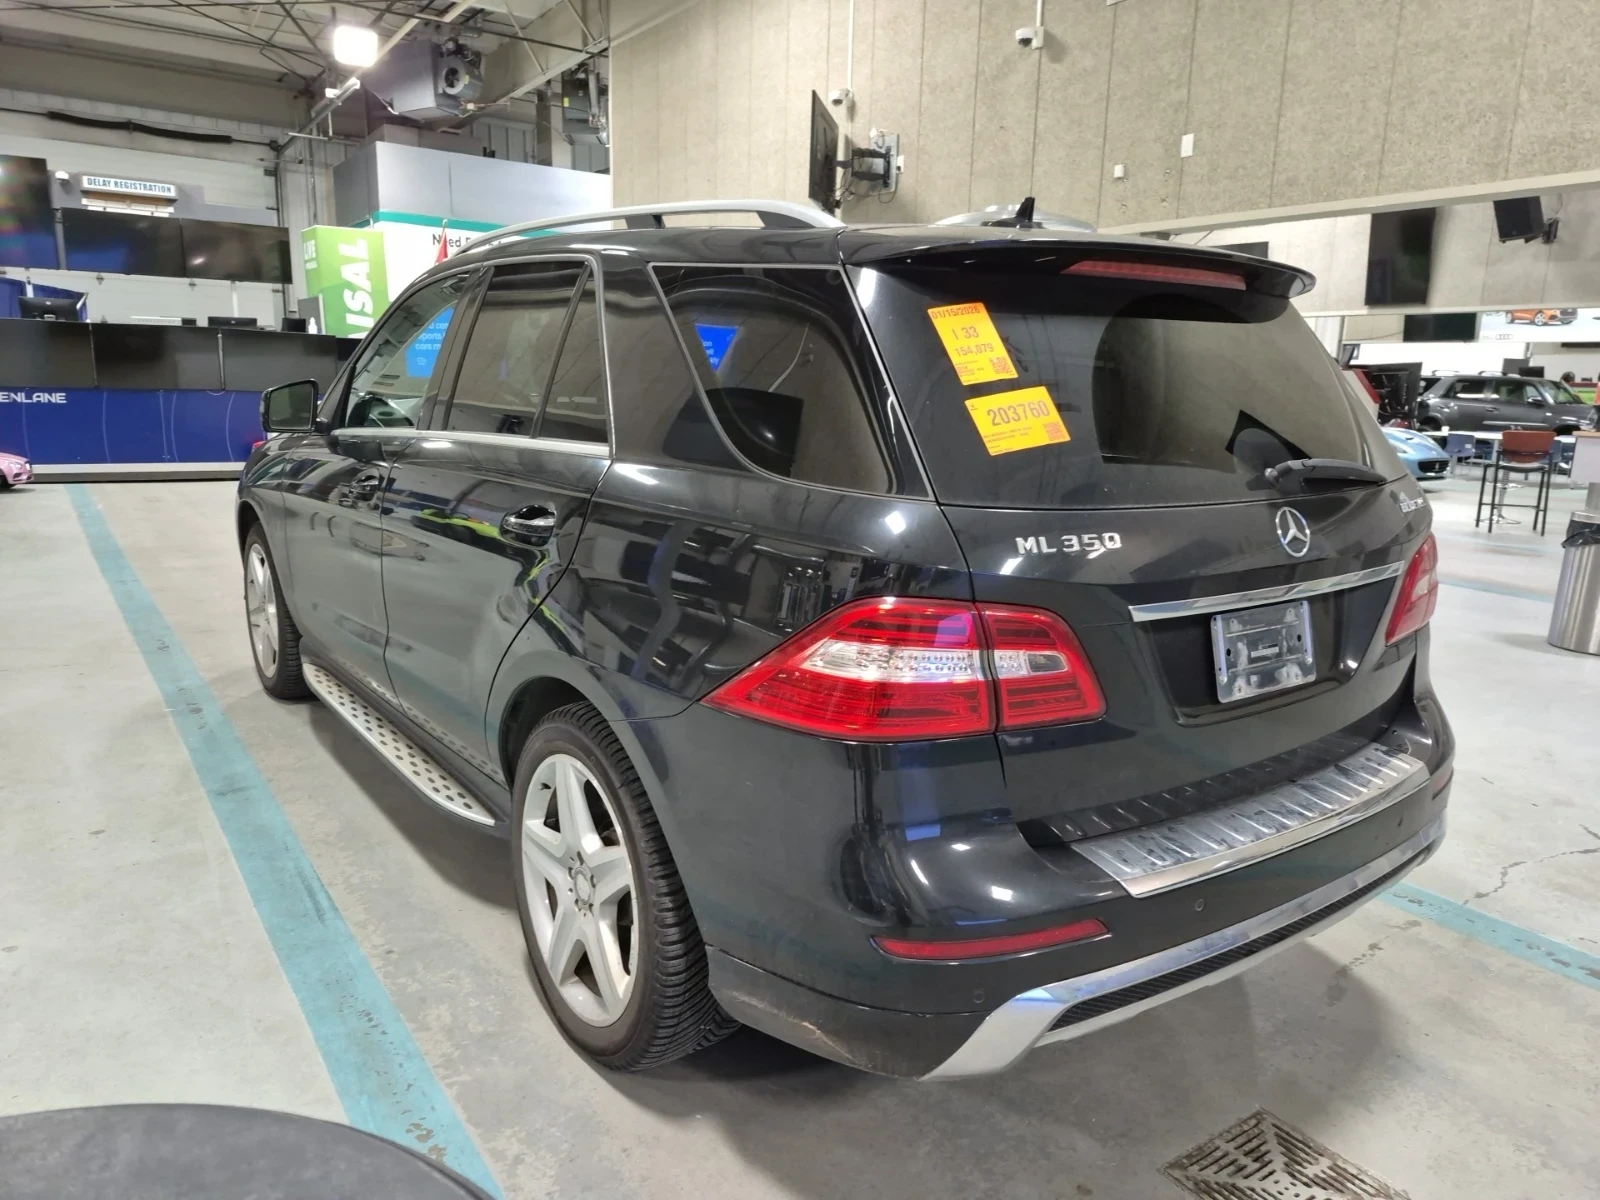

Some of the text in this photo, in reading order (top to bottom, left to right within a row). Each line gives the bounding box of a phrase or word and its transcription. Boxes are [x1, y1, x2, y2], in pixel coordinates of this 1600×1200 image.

[87, 177, 172, 194] DELAY REGISTRATION
[432, 233, 462, 248] Ned
[338, 238, 375, 338] ISAL
[931, 305, 981, 320] 01/15/2026
[961, 325, 980, 340] 33
[986, 400, 1051, 427] 203760
[1015, 532, 1122, 555] ML 350
